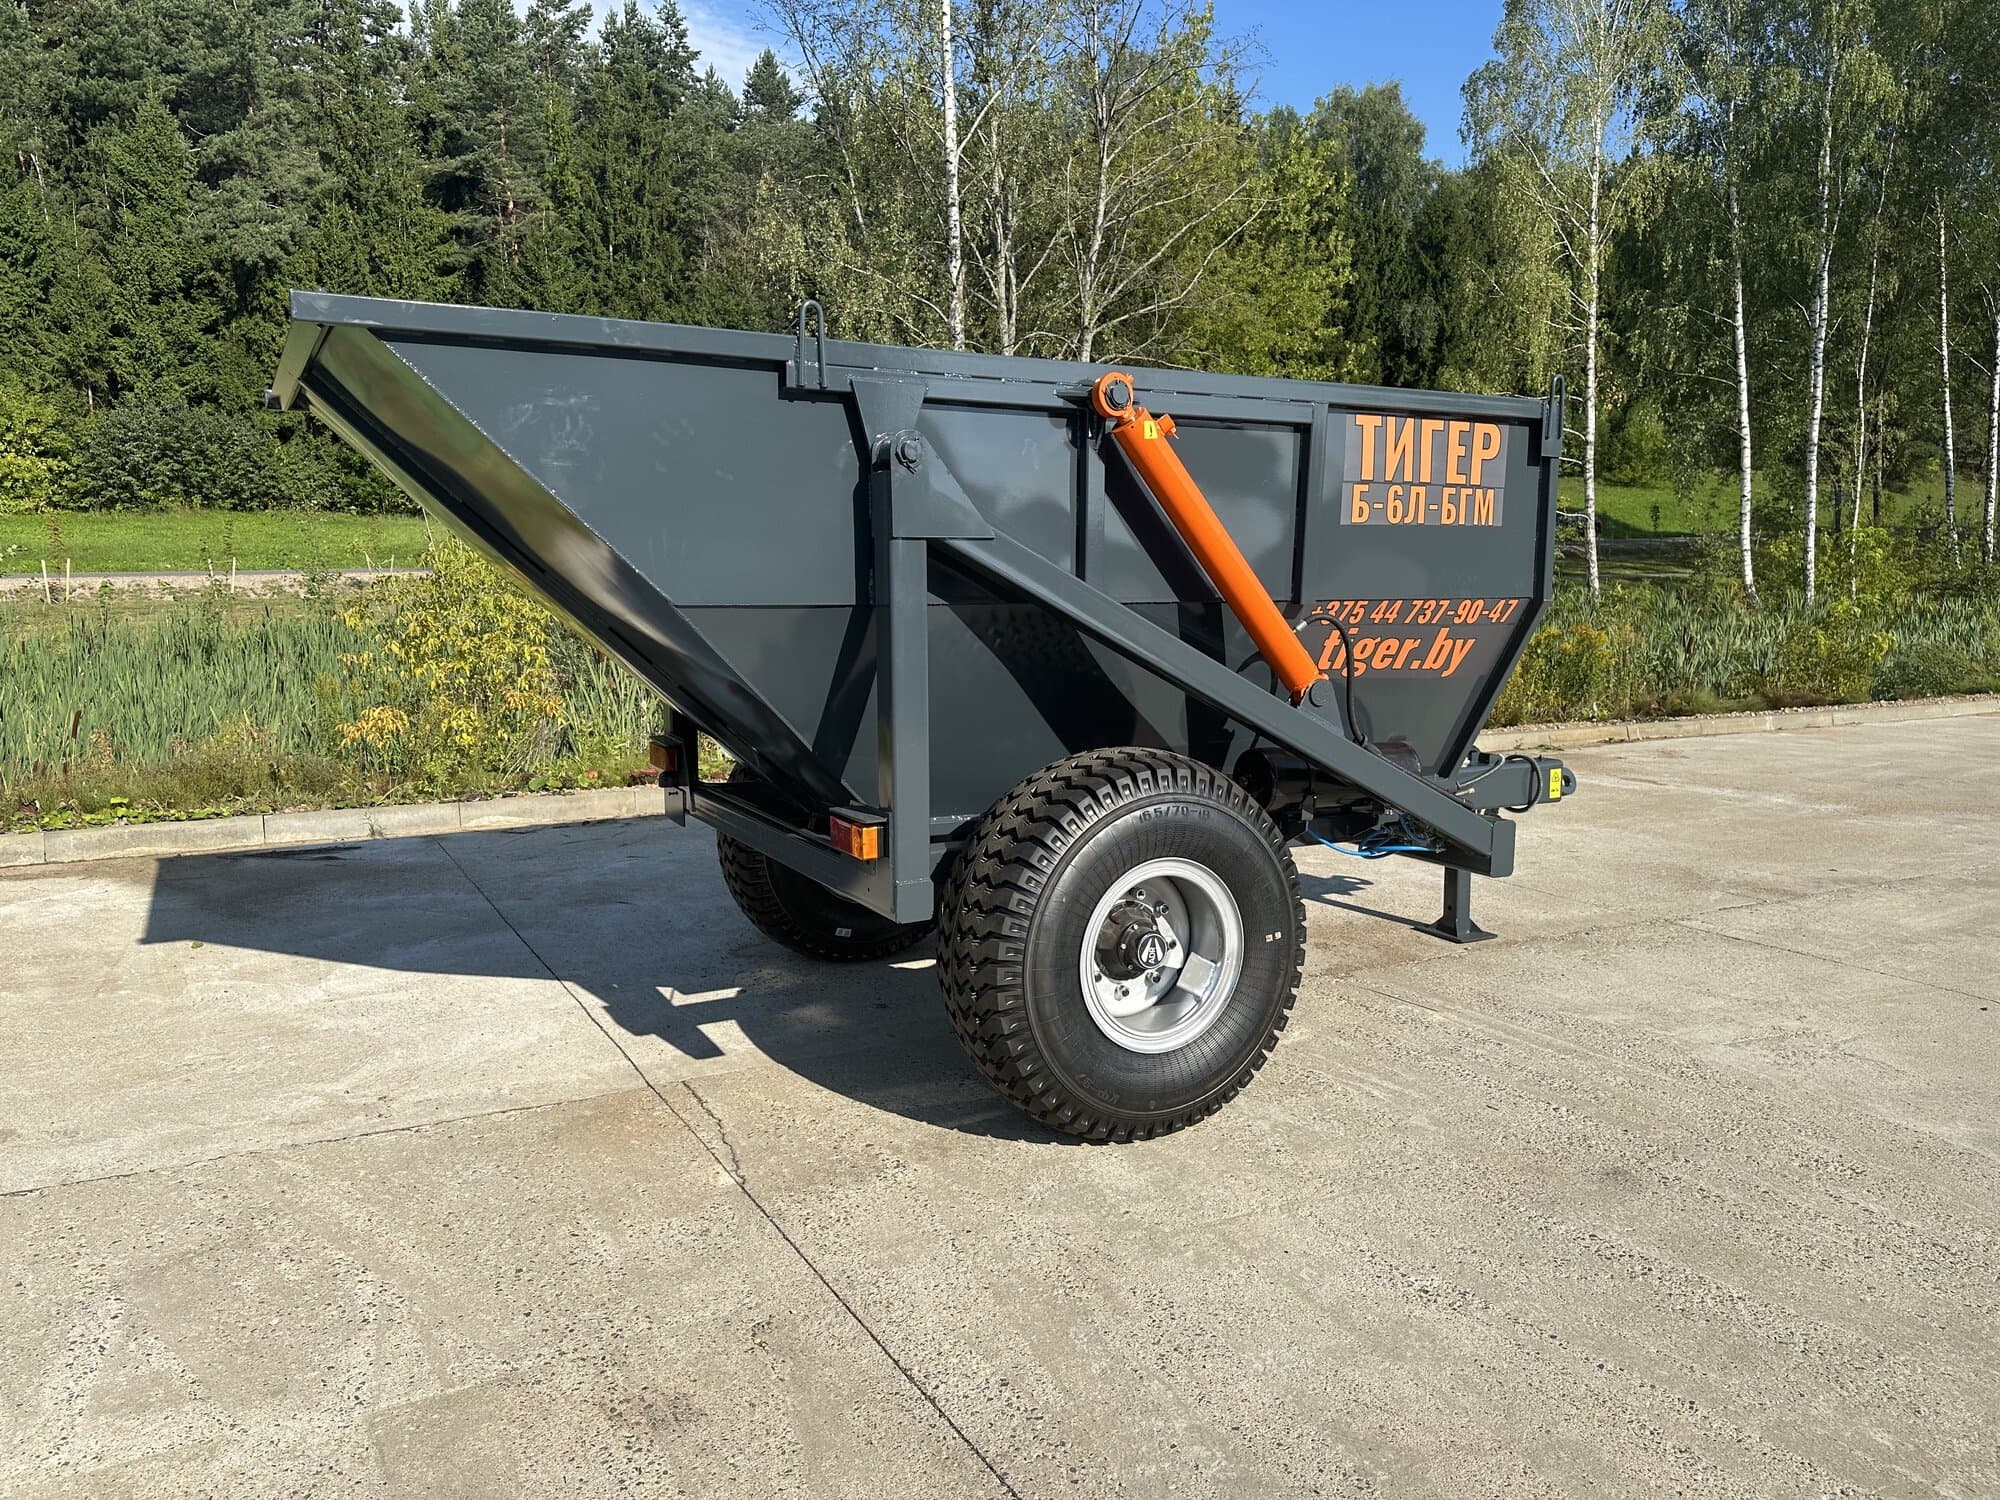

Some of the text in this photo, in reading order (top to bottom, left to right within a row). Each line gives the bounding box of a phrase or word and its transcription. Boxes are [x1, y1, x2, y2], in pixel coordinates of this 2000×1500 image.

[1355, 414, 1501, 486] ТИГЕР
[1351, 484, 1495, 526] Б-6Л-БГМ
[1369, 599, 1403, 624] 44
[1403, 598, 1519, 624] 737-90-47
[1317, 626, 1476, 678] tiger.by
